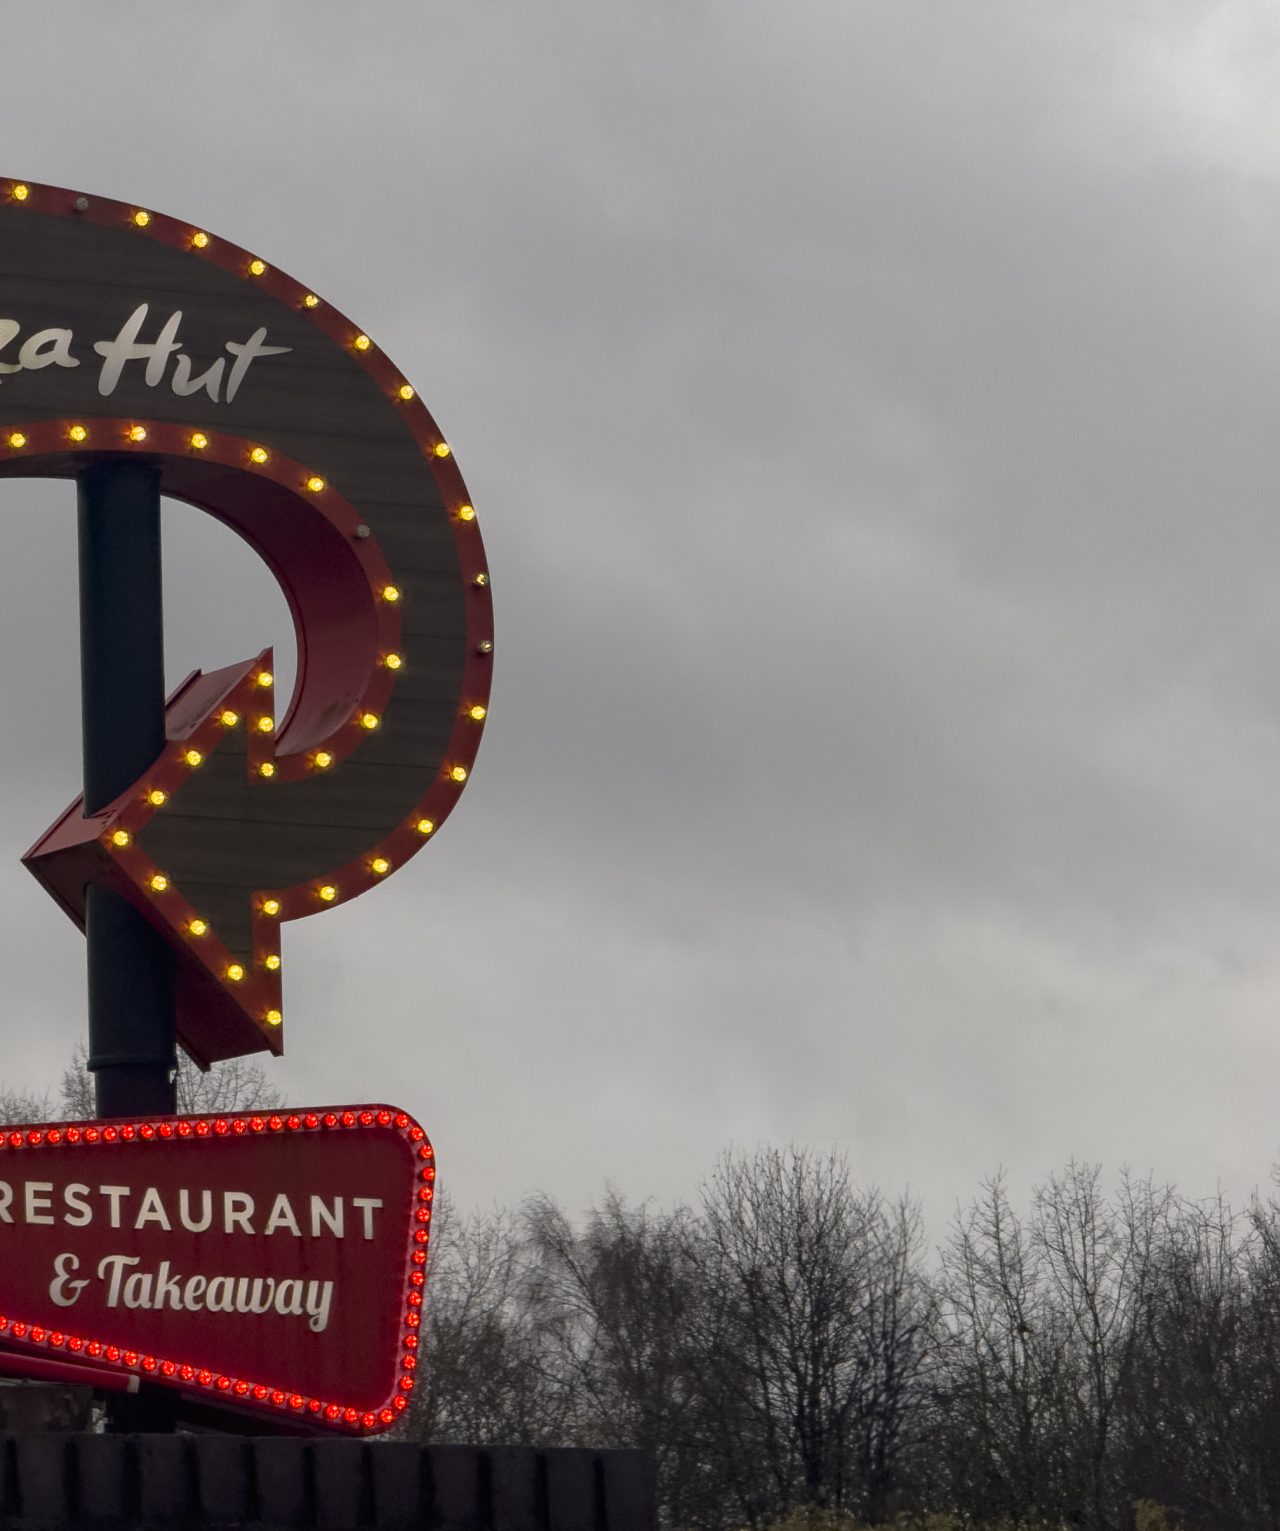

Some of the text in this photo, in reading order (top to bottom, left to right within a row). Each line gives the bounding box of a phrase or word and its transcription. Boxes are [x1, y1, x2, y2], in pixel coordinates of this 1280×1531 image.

[93, 303, 293, 405] Hut
[48, 1252, 334, 1333] & Takeaway
